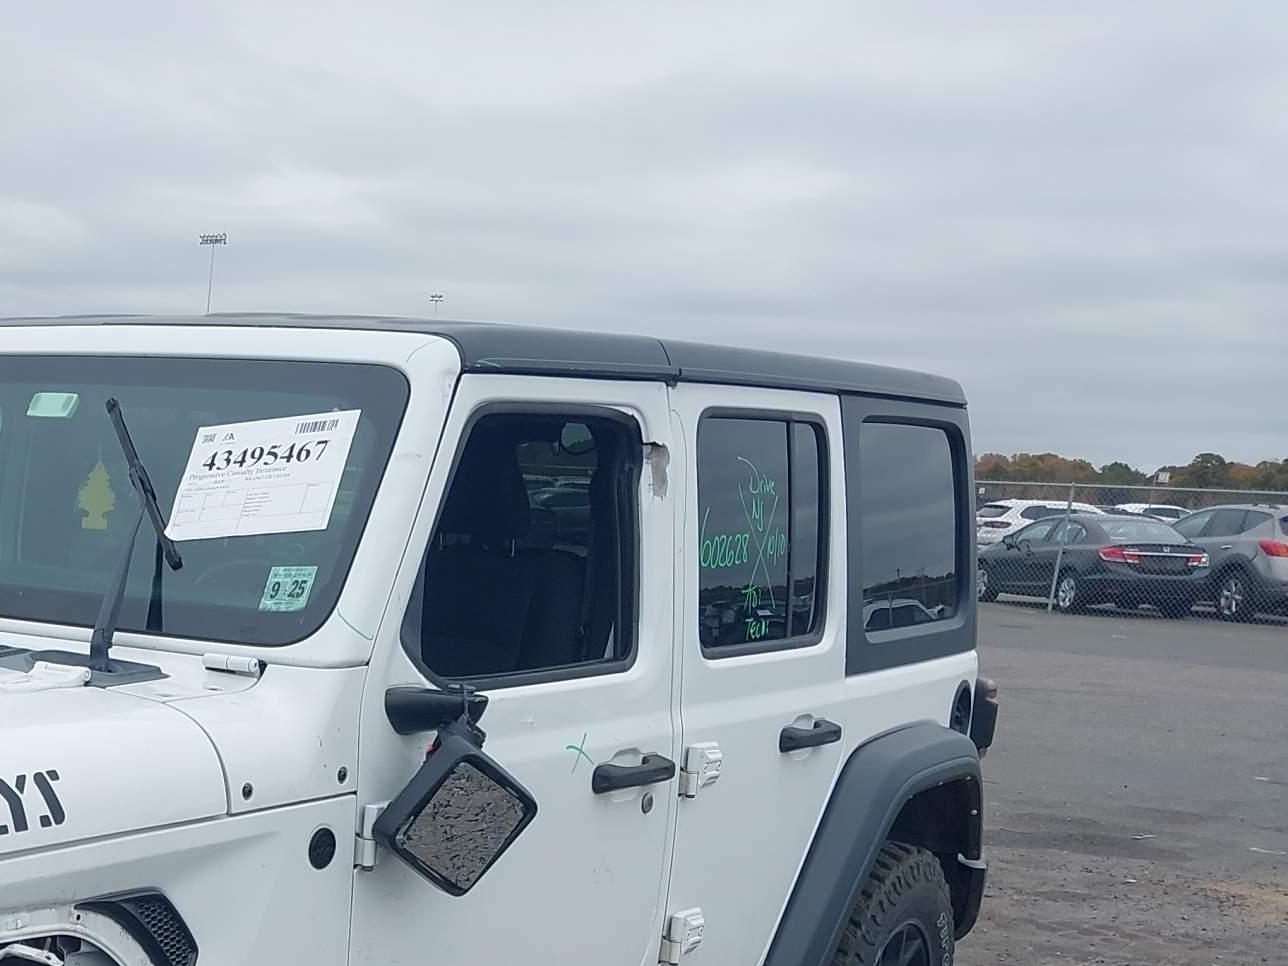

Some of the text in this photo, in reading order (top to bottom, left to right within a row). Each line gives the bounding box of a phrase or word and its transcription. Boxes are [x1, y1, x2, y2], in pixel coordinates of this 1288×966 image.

[202, 440, 330, 471] 43495467
[189, 471, 226, 482] Progressive
[227, 467, 254, 478] Casualty
[254, 465, 288, 475] Insurance
[751, 498, 765, 532] NJ
[700, 506, 751, 569] 602628
[269, 579, 308, 599] 9 25
